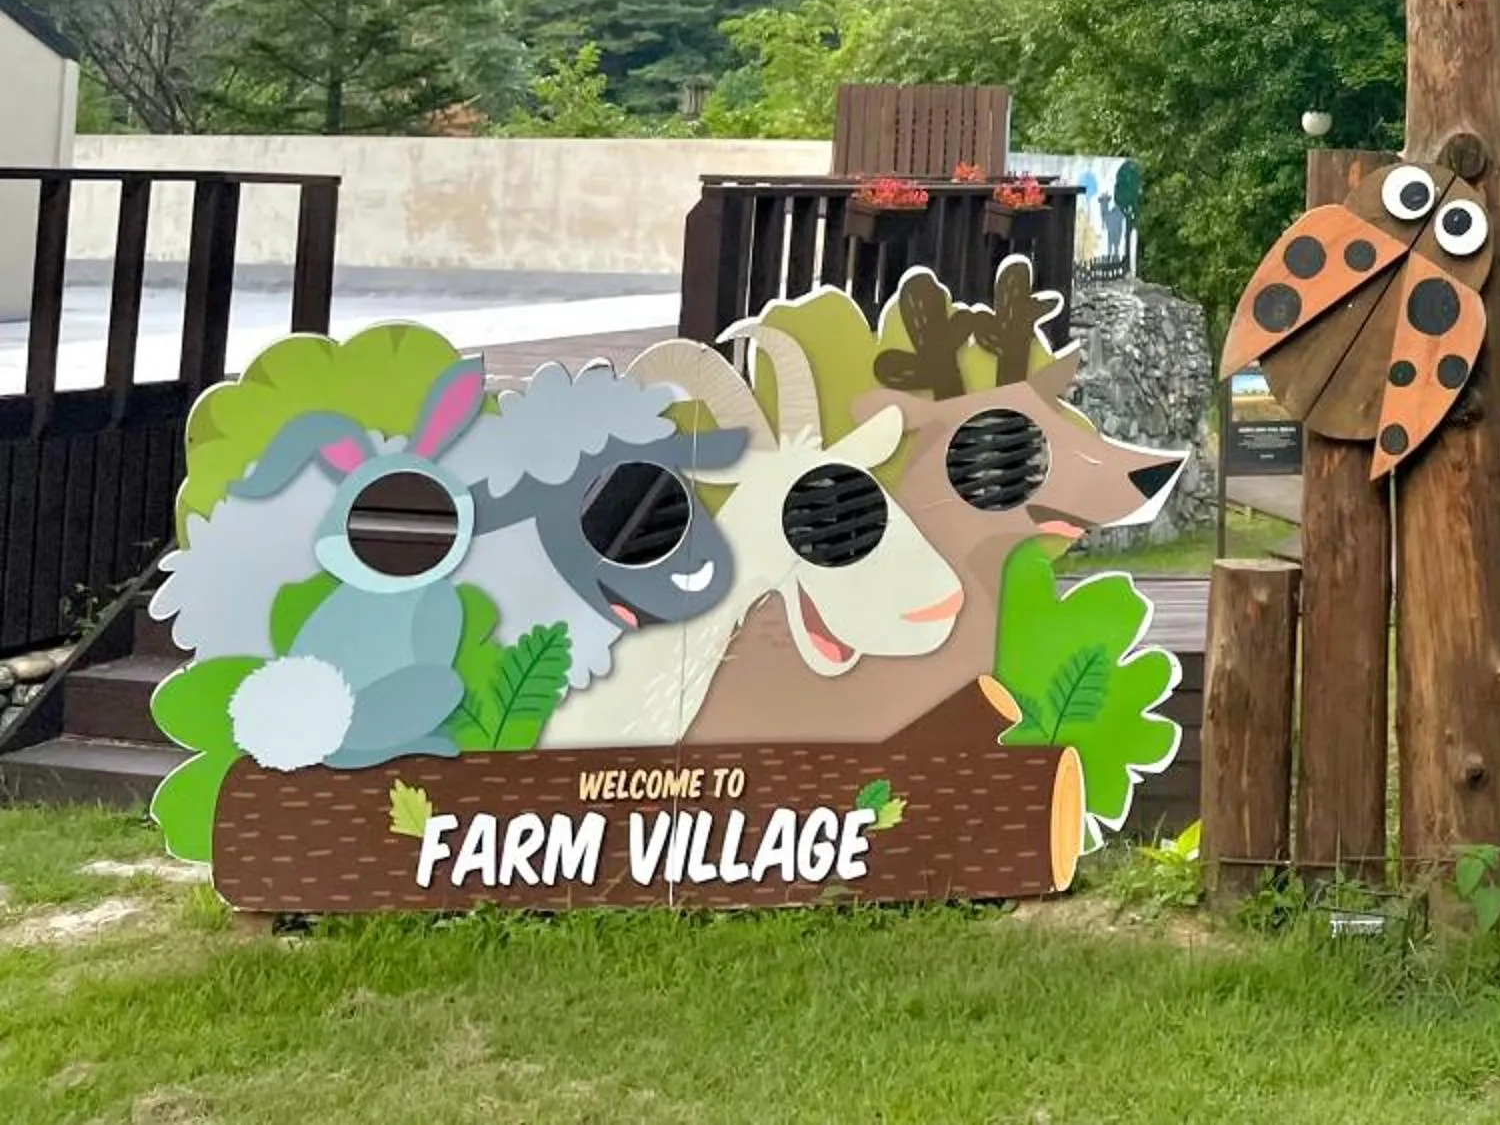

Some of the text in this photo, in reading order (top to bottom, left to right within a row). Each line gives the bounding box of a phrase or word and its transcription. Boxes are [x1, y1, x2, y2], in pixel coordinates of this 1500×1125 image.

[578, 767, 746, 801] WELCOME TO
[415, 806, 877, 888] FARM VILLAGE
